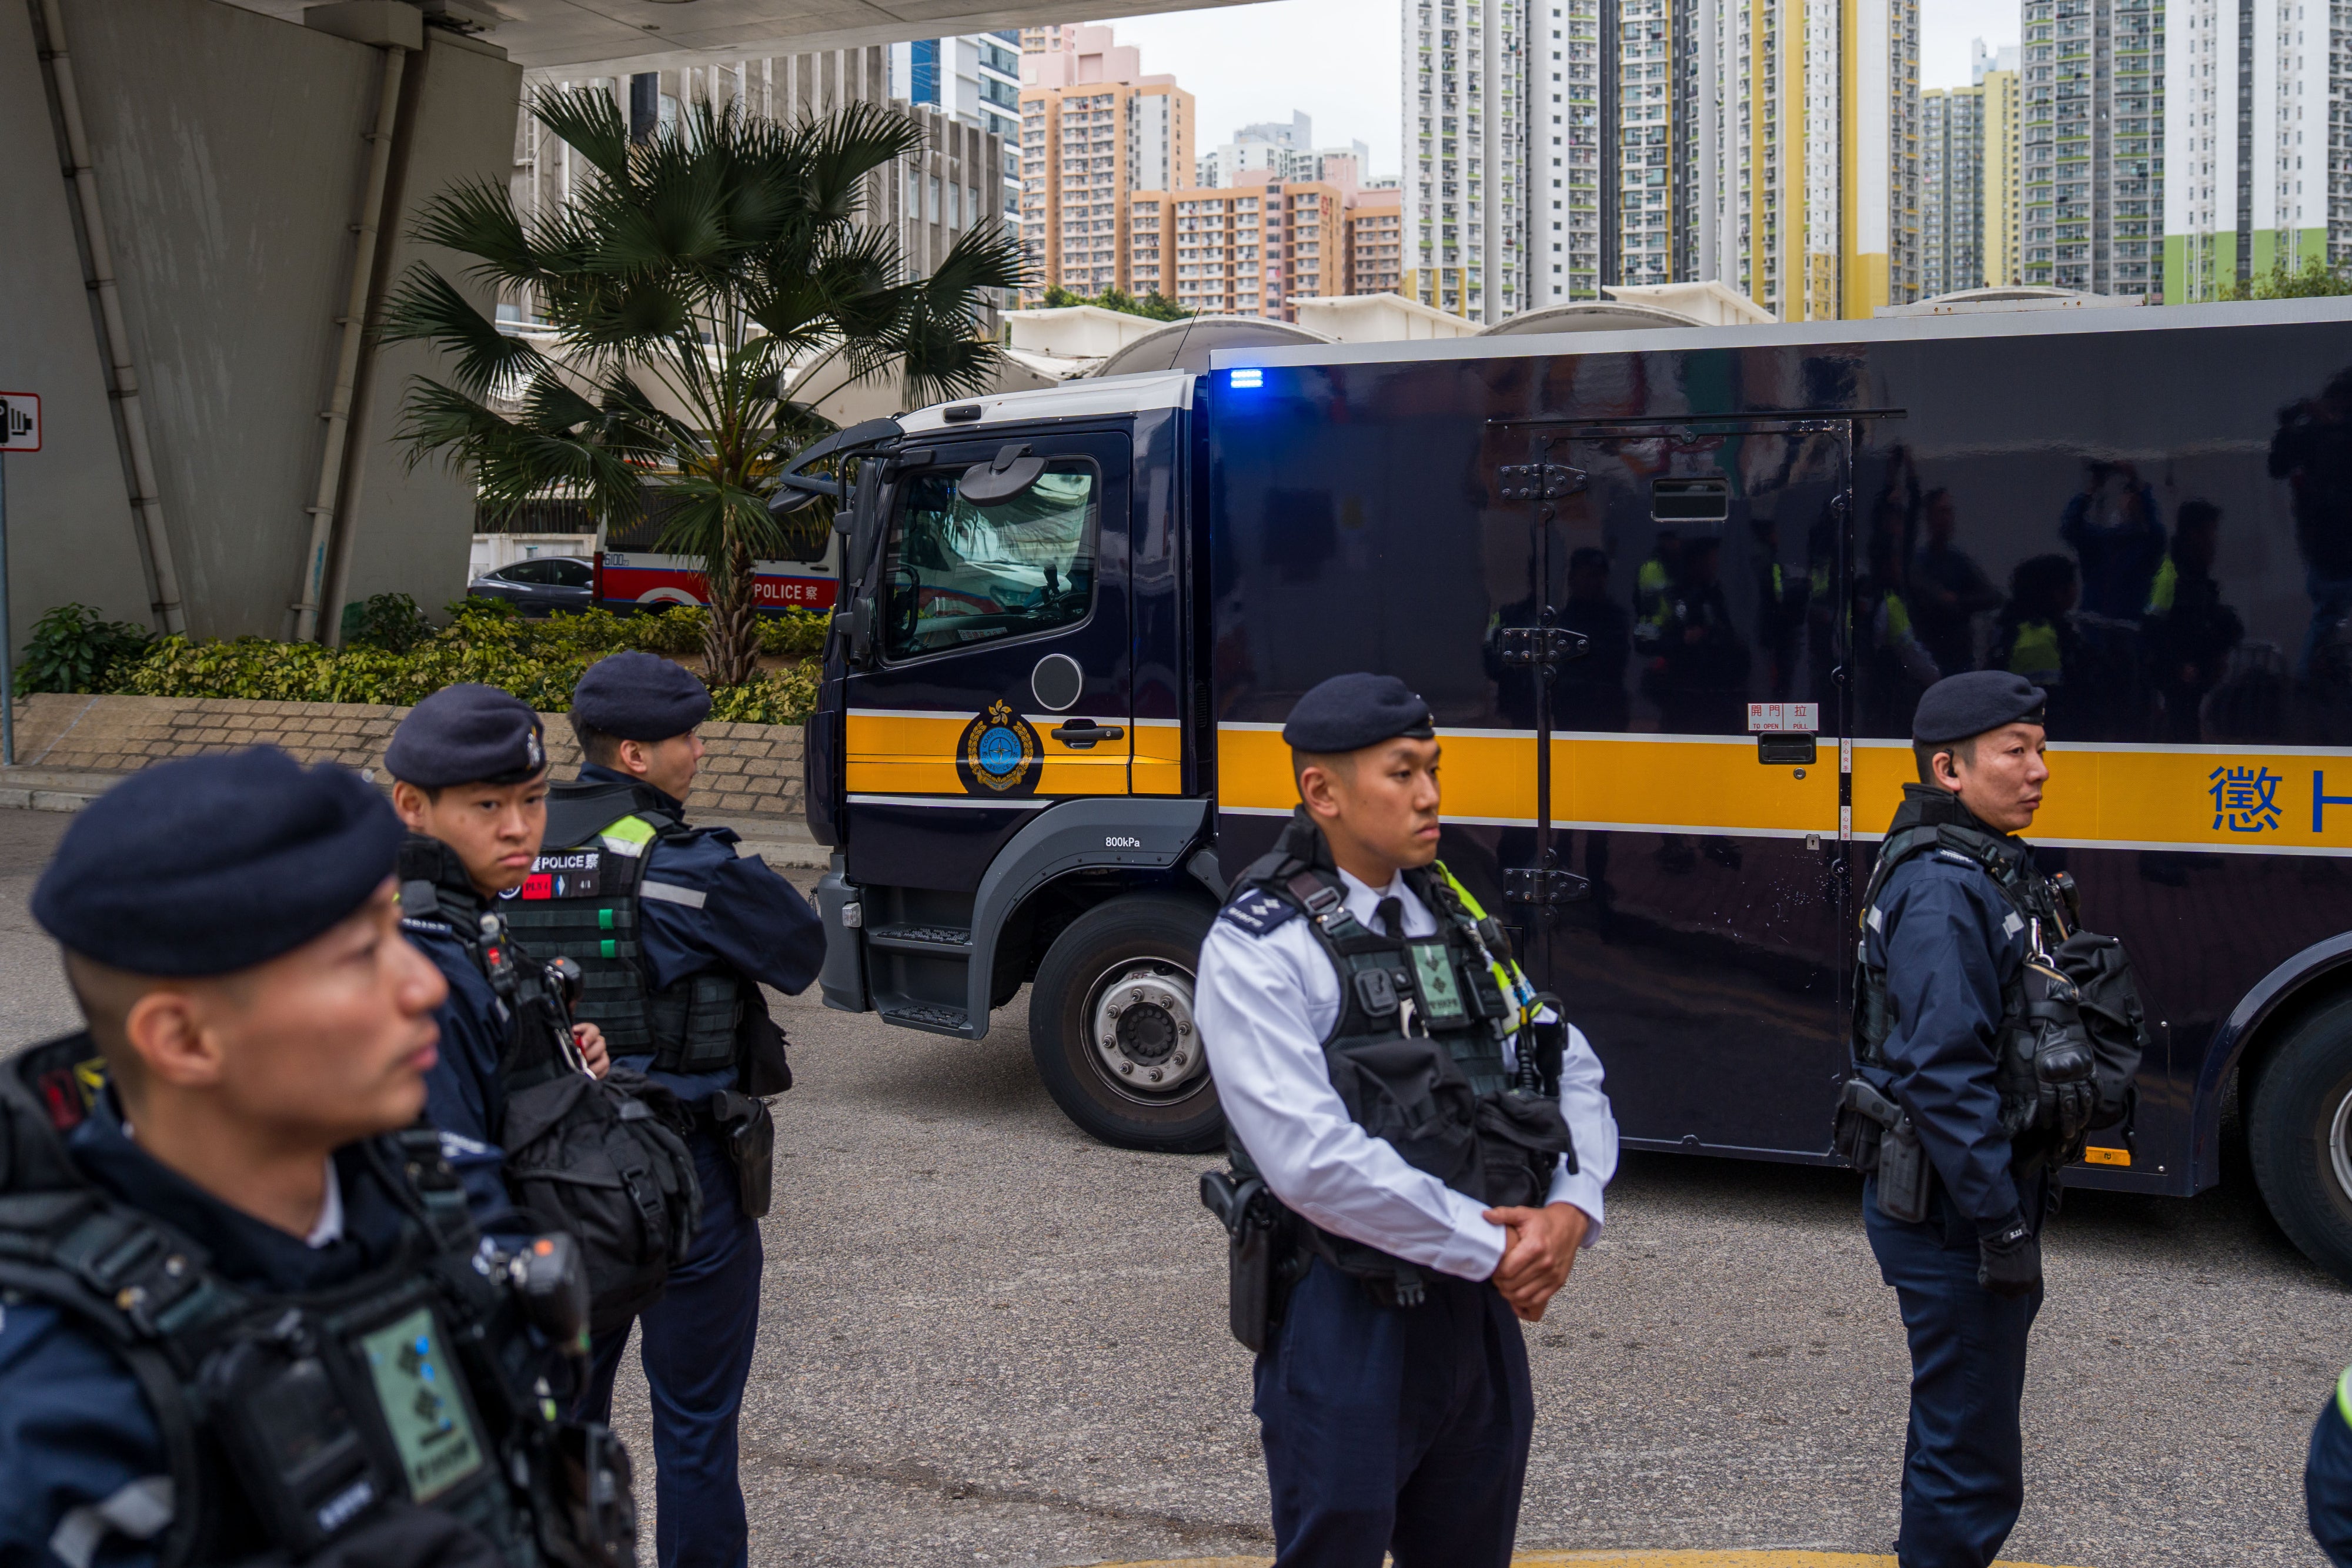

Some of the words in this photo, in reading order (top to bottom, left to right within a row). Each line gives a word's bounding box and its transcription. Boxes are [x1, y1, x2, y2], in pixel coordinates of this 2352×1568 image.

[754, 584, 802, 600] POLICE
[806, 586, 817, 600] 察
[1752, 705, 1780, 716] 開門
[1794, 706, 1806, 716] 拉
[2209, 766, 2283, 833] 懲
[1105, 837, 1140, 847] 800kPa
[542, 855, 584, 870] POLICE
